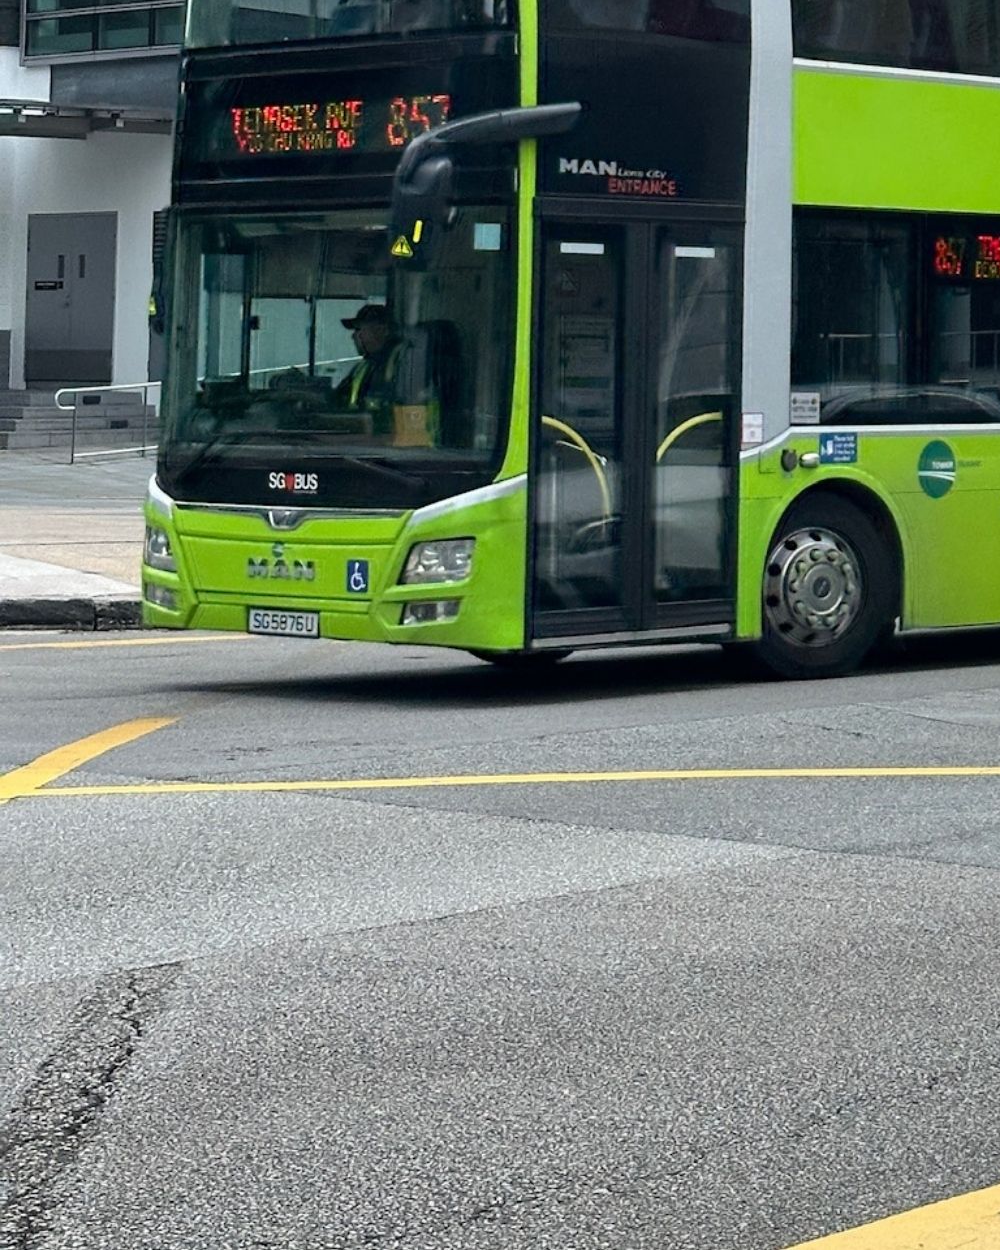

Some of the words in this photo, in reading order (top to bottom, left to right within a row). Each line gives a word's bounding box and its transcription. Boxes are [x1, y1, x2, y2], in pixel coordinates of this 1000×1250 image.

[231, 103, 318, 132] TEMASEK
[326, 101, 363, 128] AVE
[387, 94, 451, 146] 857
[336, 129, 356, 148] RD
[559, 157, 617, 176] MAN
[608, 177, 676, 195] ENTRANCE
[268, 472, 286, 489] SG
[294, 473, 318, 490] BUS
[248, 557, 315, 582] MAN
[252, 613, 315, 632] SG5876U
